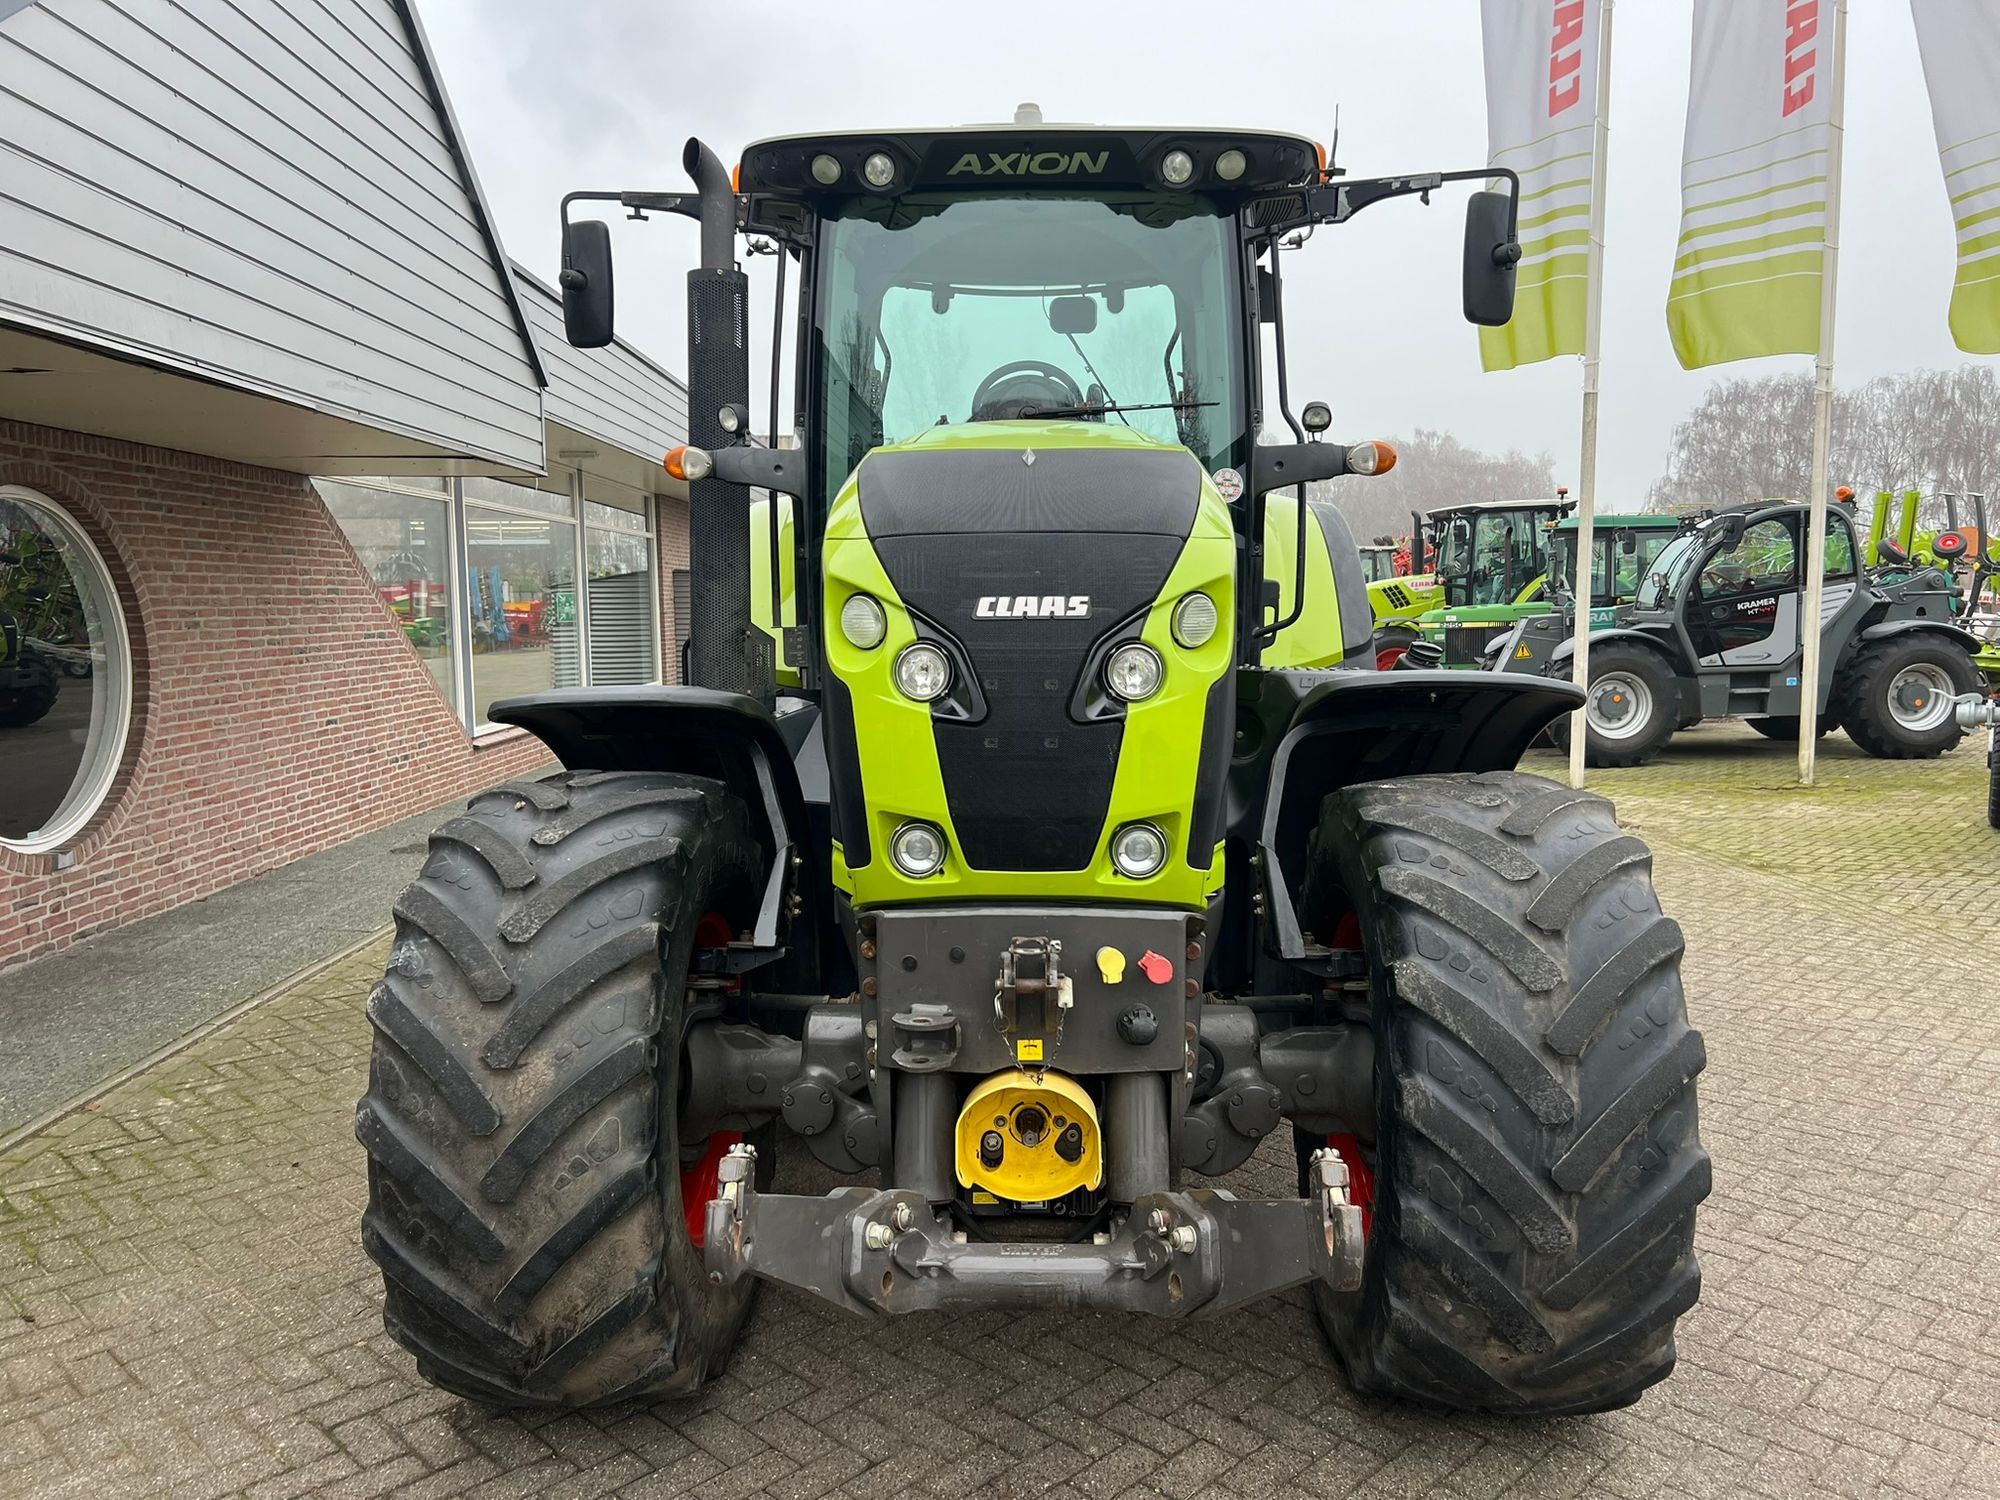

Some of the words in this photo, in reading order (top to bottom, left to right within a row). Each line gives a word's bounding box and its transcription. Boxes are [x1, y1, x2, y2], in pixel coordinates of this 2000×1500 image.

[946, 151, 1110, 176] AXION
[976, 595, 1090, 617] CLAAS
[1737, 597, 1776, 610] KRAMER
